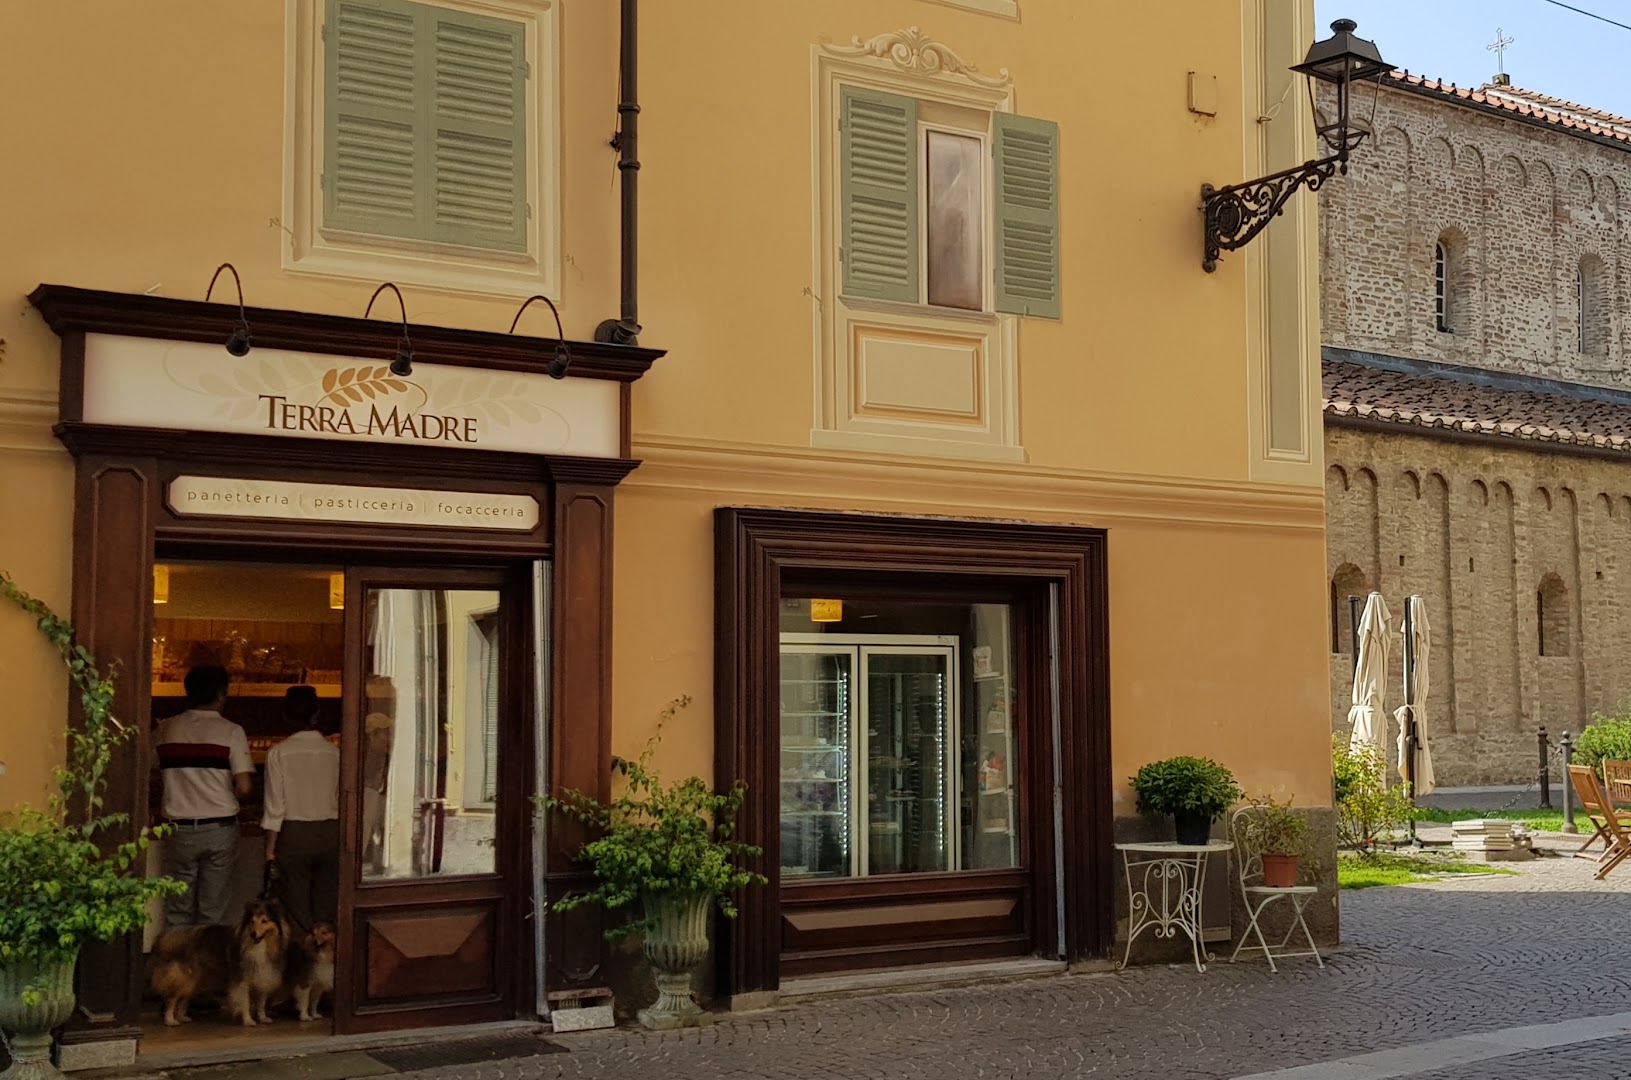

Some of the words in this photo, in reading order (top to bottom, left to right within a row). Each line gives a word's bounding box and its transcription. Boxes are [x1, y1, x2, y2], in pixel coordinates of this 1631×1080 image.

[258, 394, 357, 435] TERRA
[367, 403, 478, 443] MADRE
[187, 491, 289, 505] panetteria
[314, 497, 414, 512] pasticceria
[438, 502, 524, 517] focacceria
